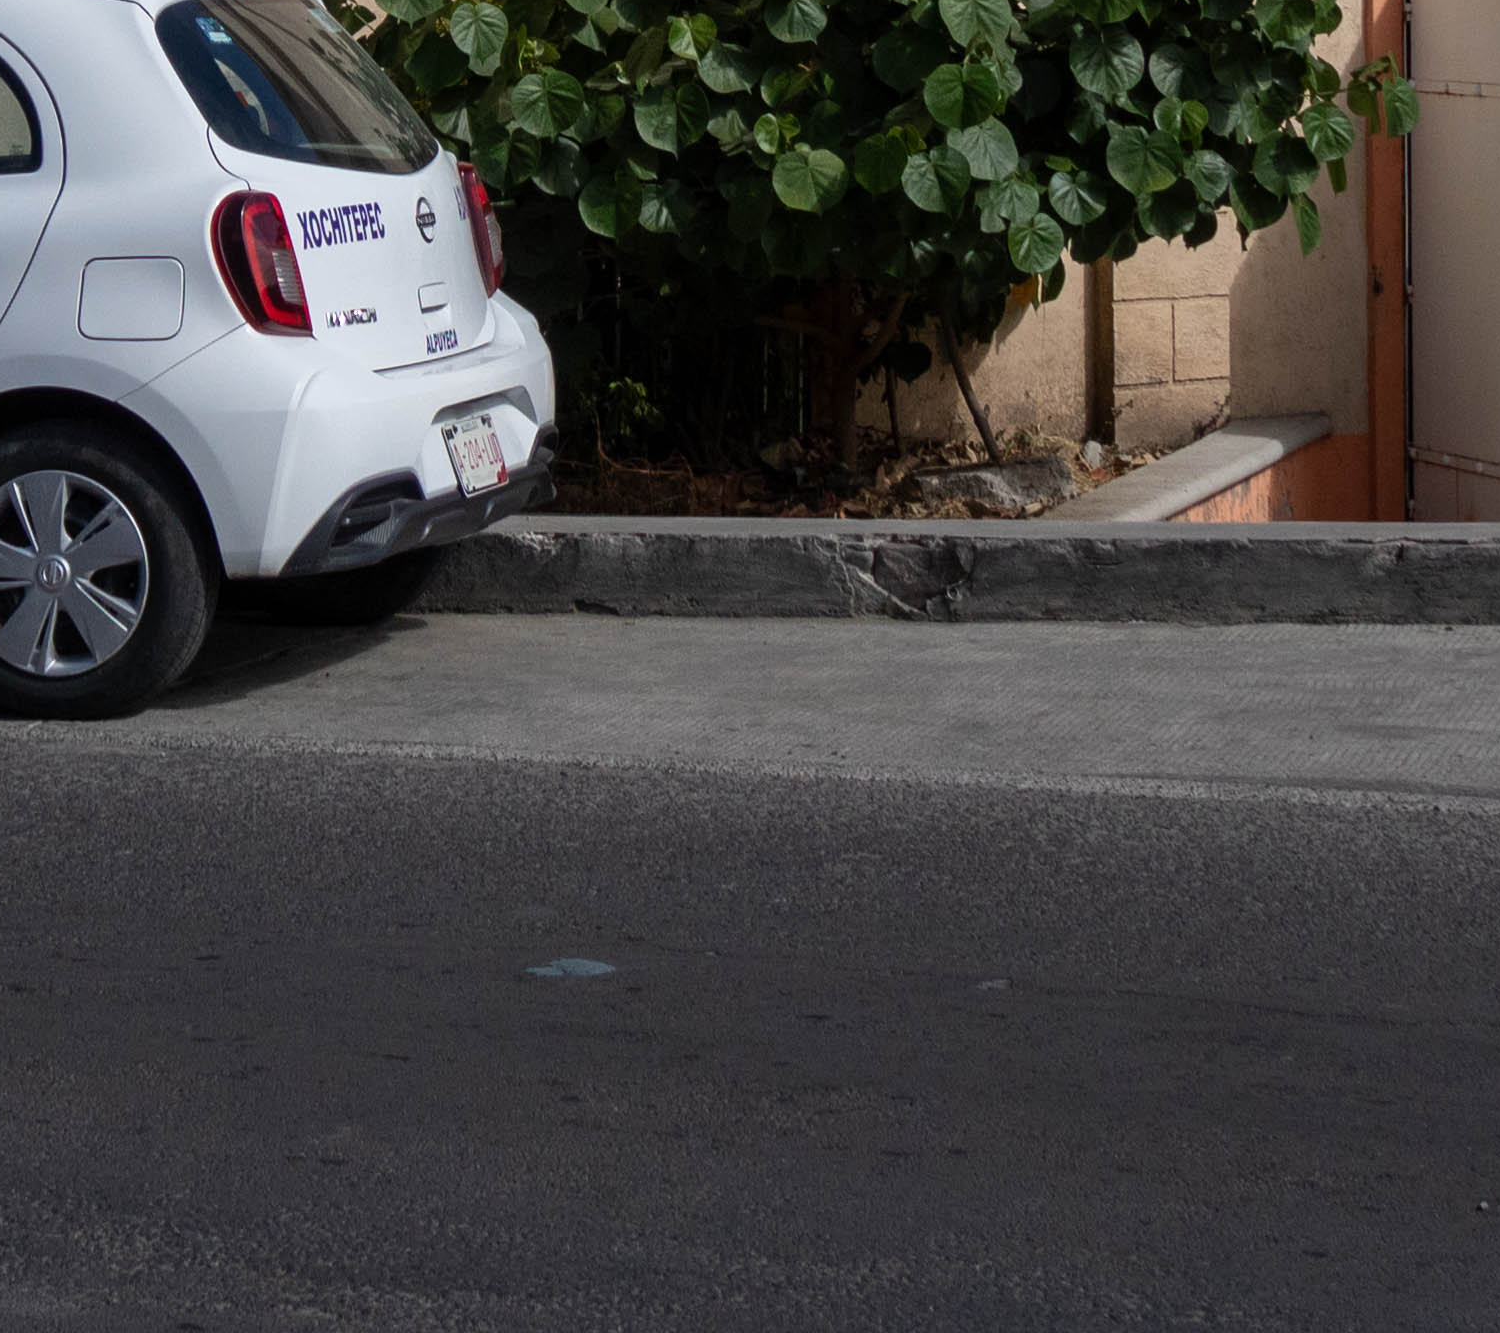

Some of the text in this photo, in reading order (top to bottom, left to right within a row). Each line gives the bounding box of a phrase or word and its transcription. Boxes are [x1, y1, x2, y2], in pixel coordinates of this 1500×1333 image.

[296, 201, 386, 250] XOCHITEPEC
[425, 328, 459, 355] ALPUYECA
[453, 432, 502, 471] A-204-LUD
